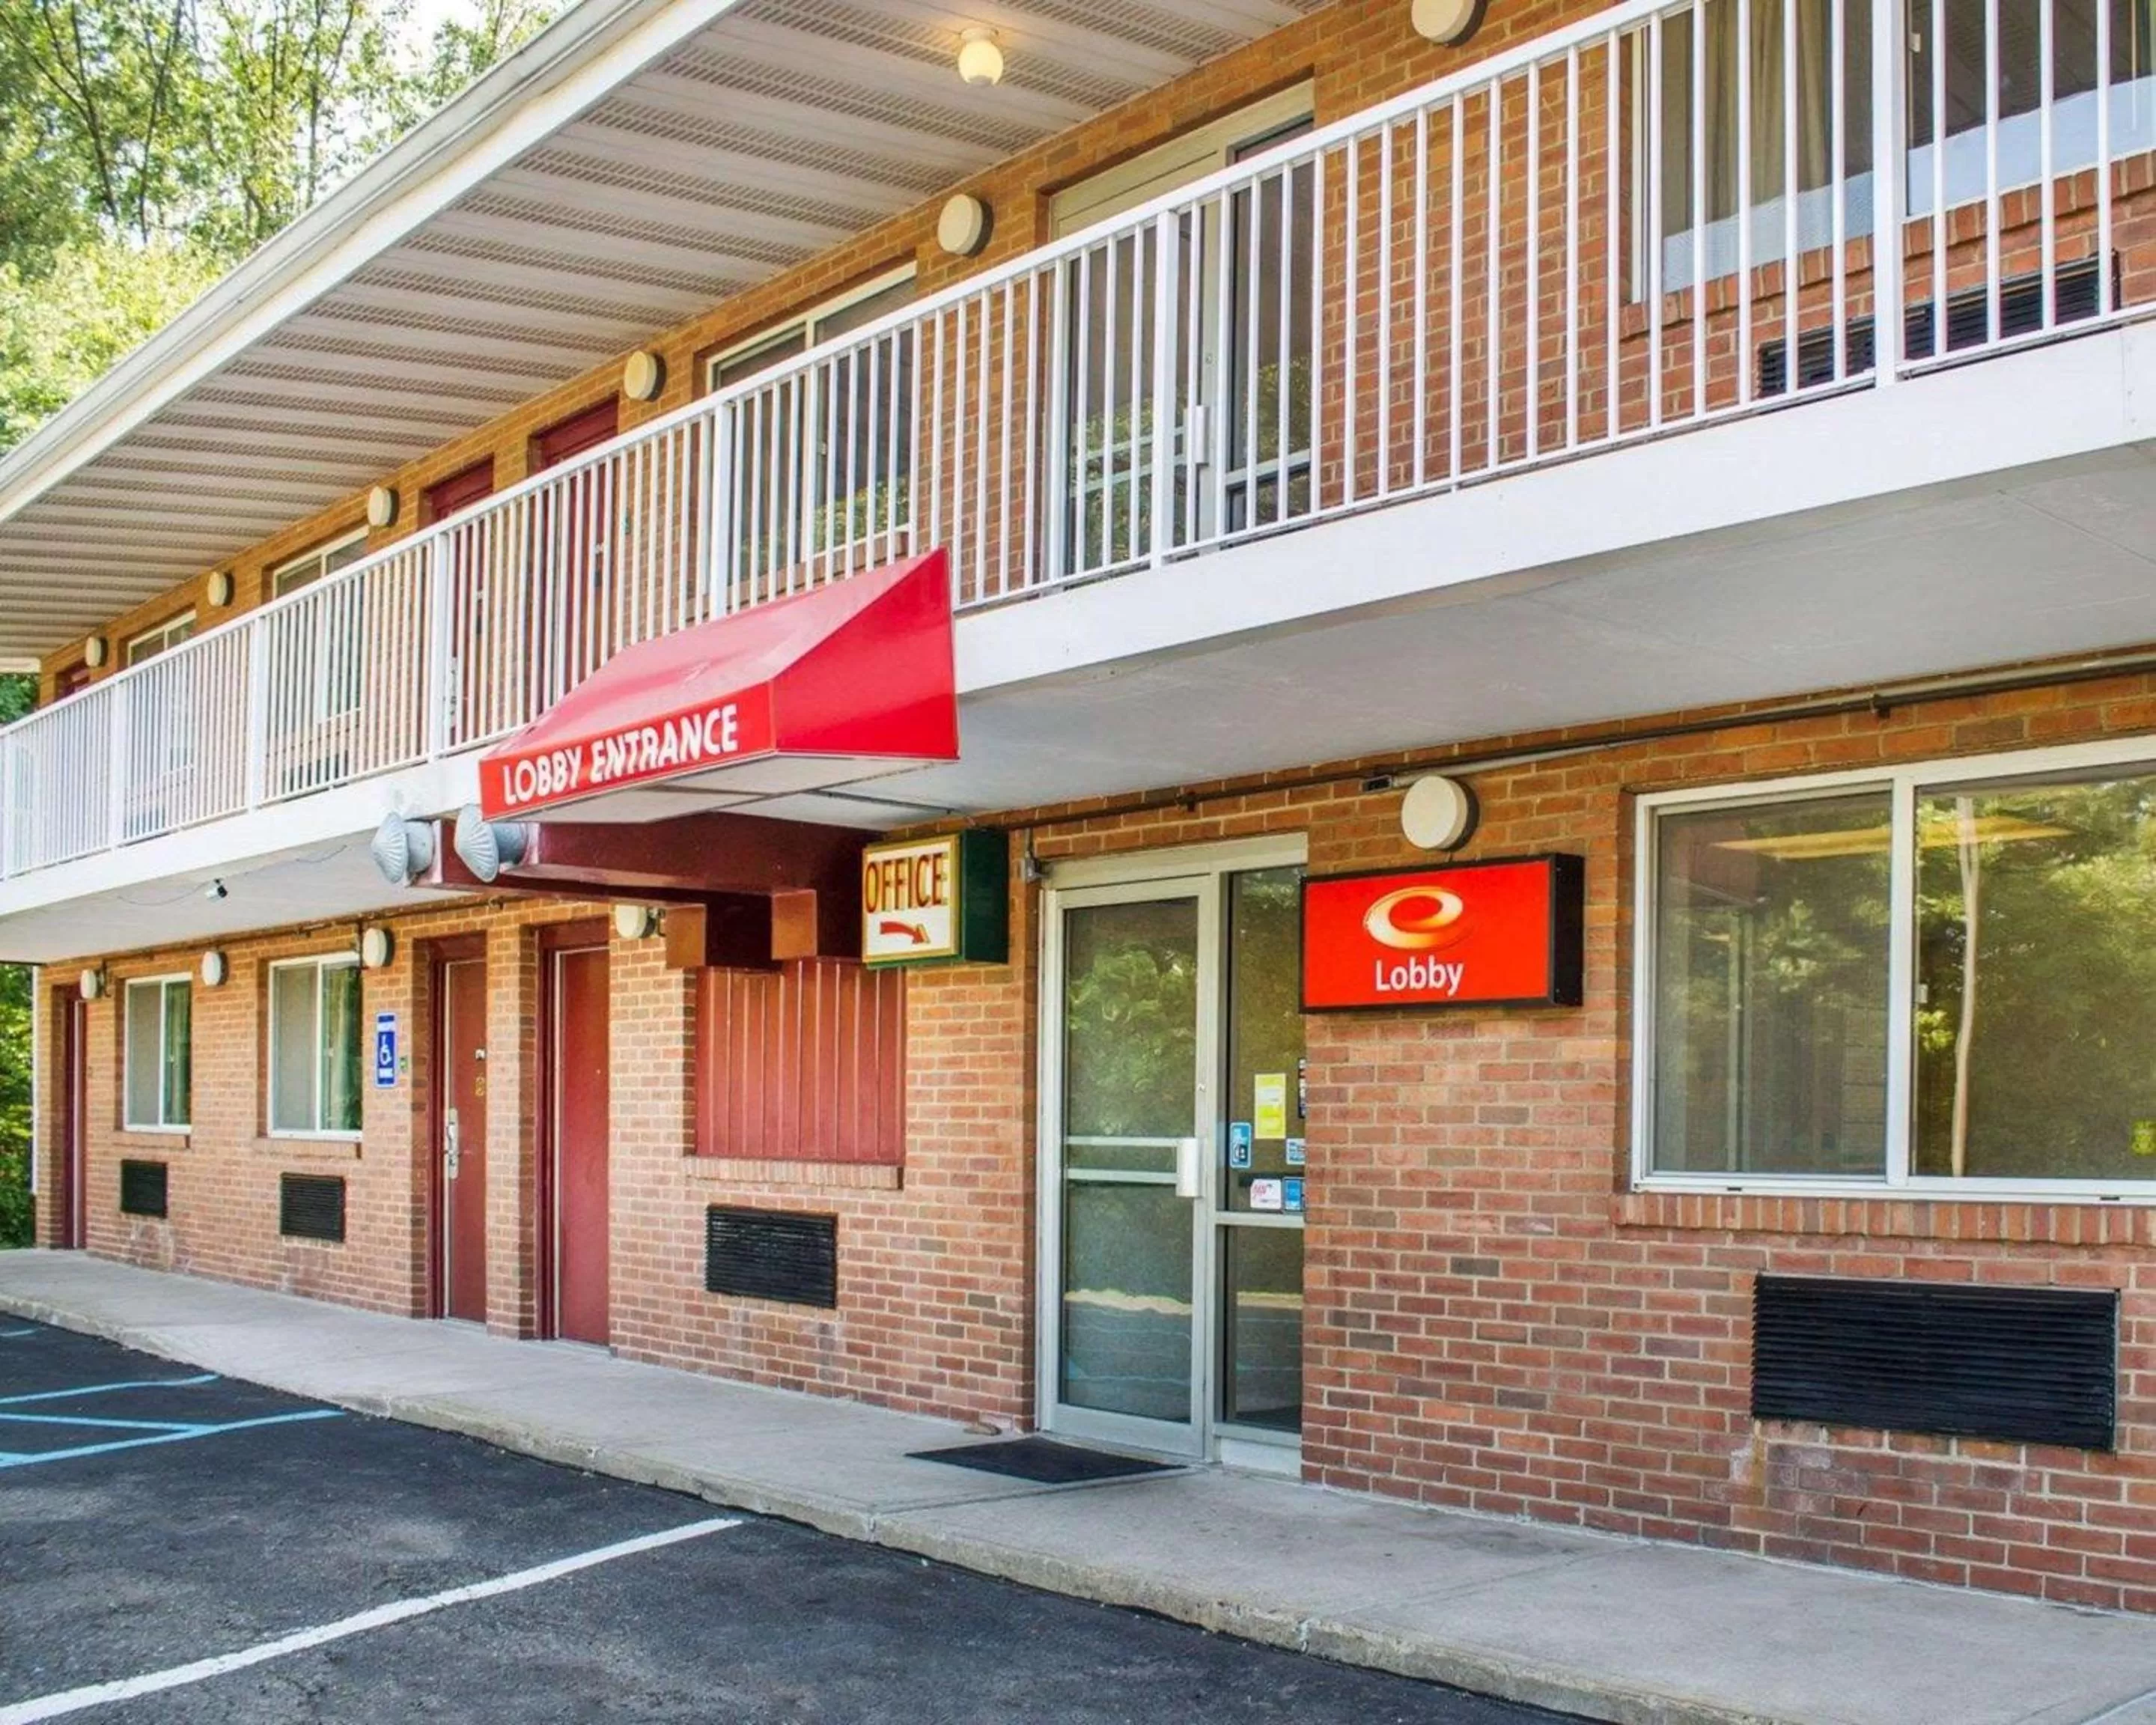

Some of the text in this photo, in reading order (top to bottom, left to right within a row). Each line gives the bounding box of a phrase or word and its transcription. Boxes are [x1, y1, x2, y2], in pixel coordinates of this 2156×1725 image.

[503, 704, 738, 806] LOBBY ENTRANCE
[865, 852, 948, 913] OFFICE
[1375, 955, 1464, 996] Lobby
